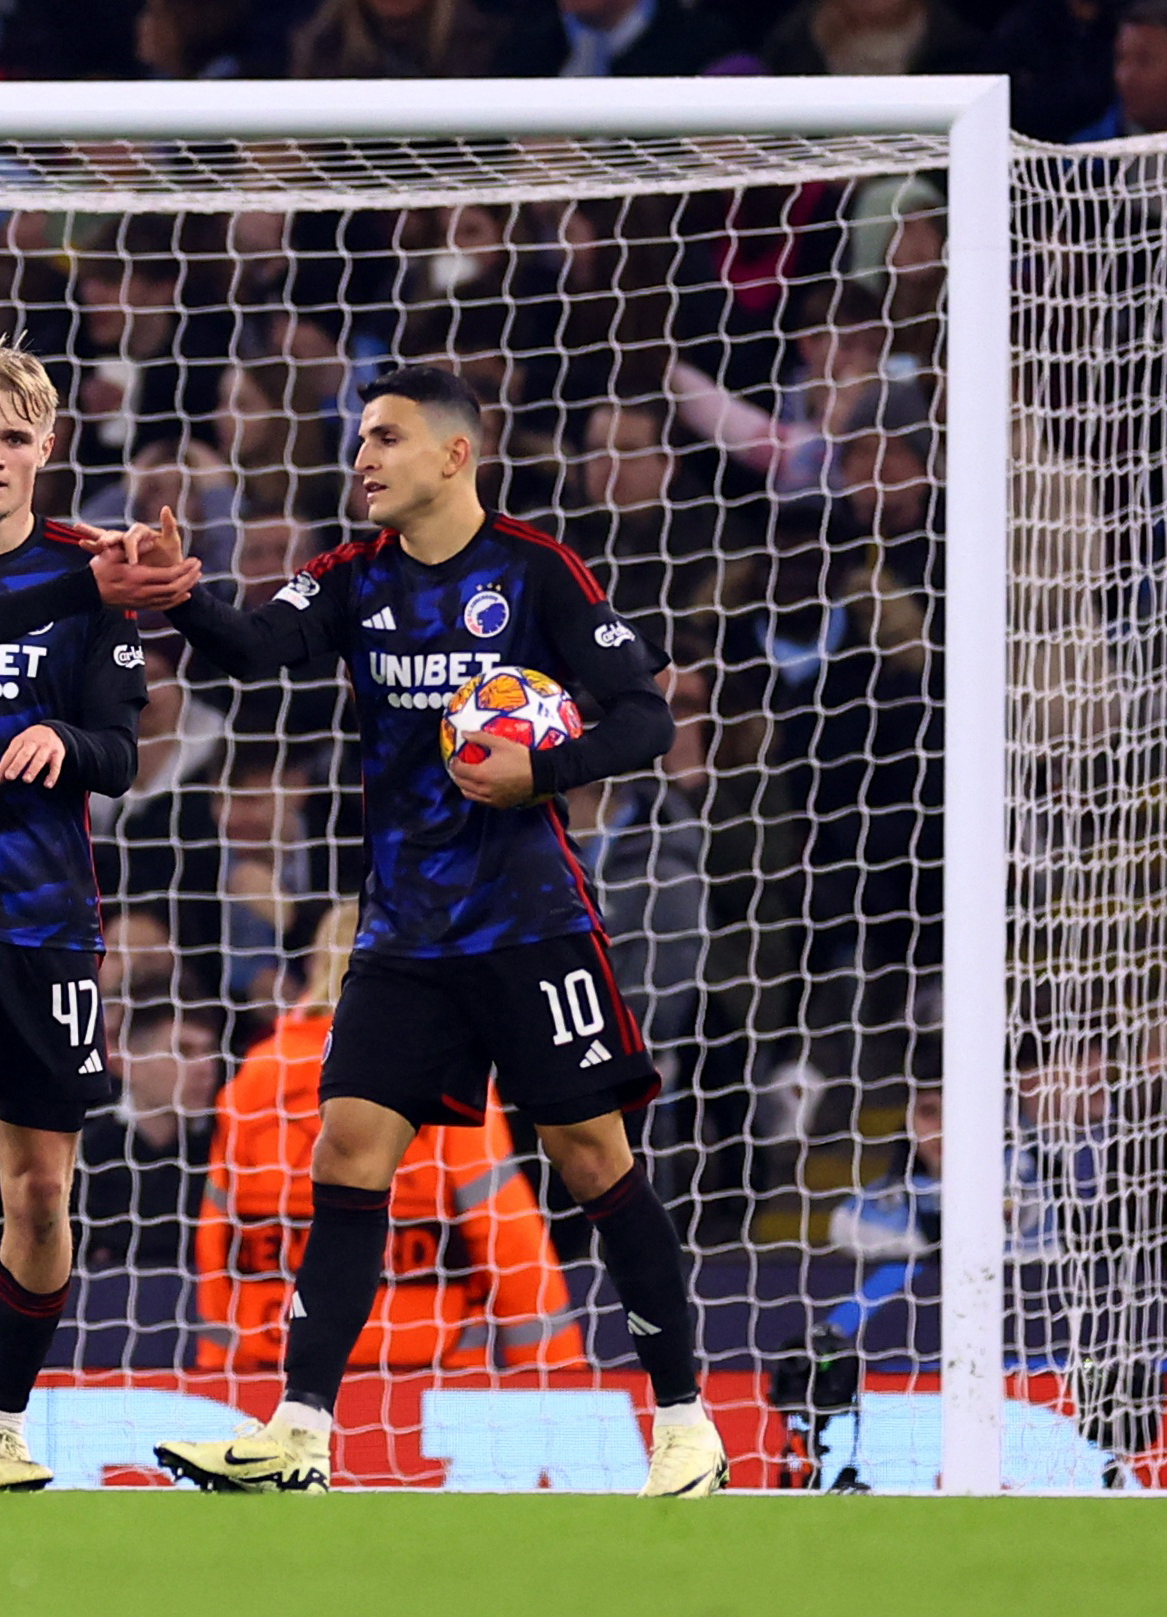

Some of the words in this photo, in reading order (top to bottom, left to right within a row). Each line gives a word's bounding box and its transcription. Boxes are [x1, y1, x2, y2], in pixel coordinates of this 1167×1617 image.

[369, 651, 501, 688] UNIBET
[51, 979, 98, 1046] 47
[539, 968, 605, 1046] 10
